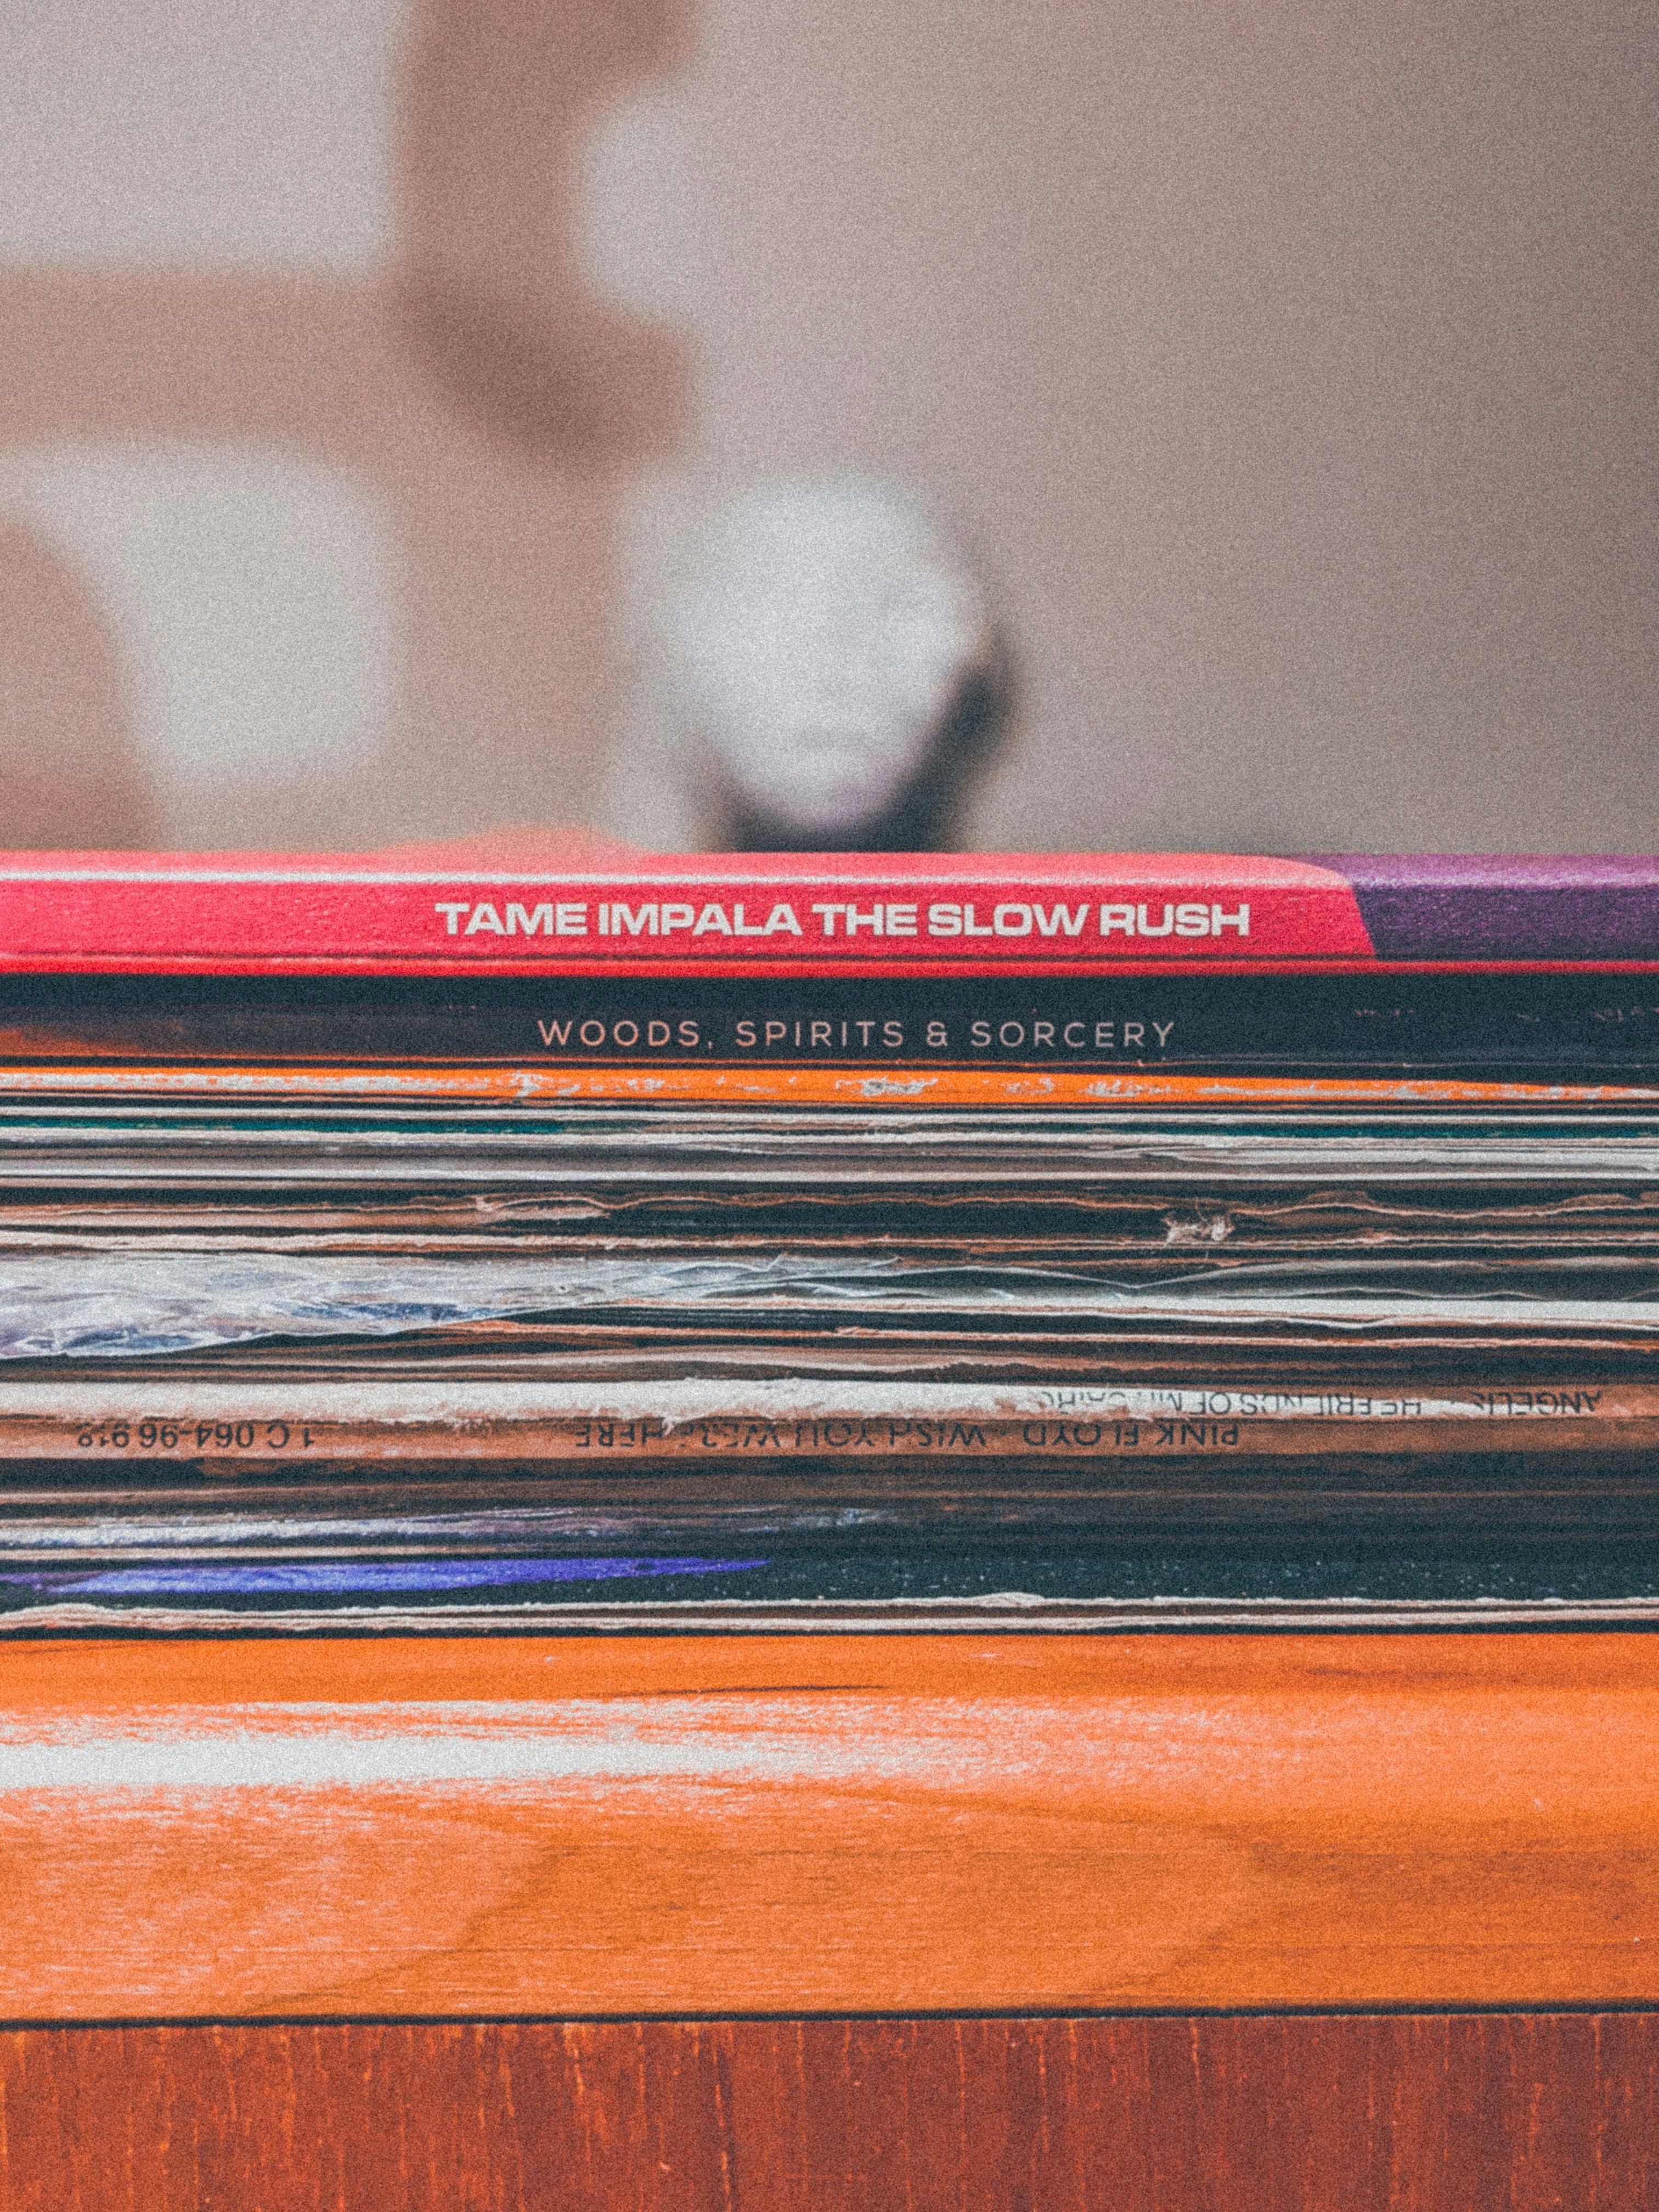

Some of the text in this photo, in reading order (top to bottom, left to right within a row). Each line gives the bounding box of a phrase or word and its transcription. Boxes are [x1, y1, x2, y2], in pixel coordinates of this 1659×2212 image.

[434, 903, 1250, 936] TAME IMPALA THE SLOW RUSH
[538, 1020, 1175, 1048] WOODS, SPIRITS & SORCERY
[1188, 1391, 1231, 1415] OF
[138, 1424, 255, 1448] 064-96
[266, 1424, 289, 1448] C
[575, 1423, 664, 1447] HERE
[794, 1423, 874, 1447] YOU
[1155, 1424, 1239, 1446] PINK
